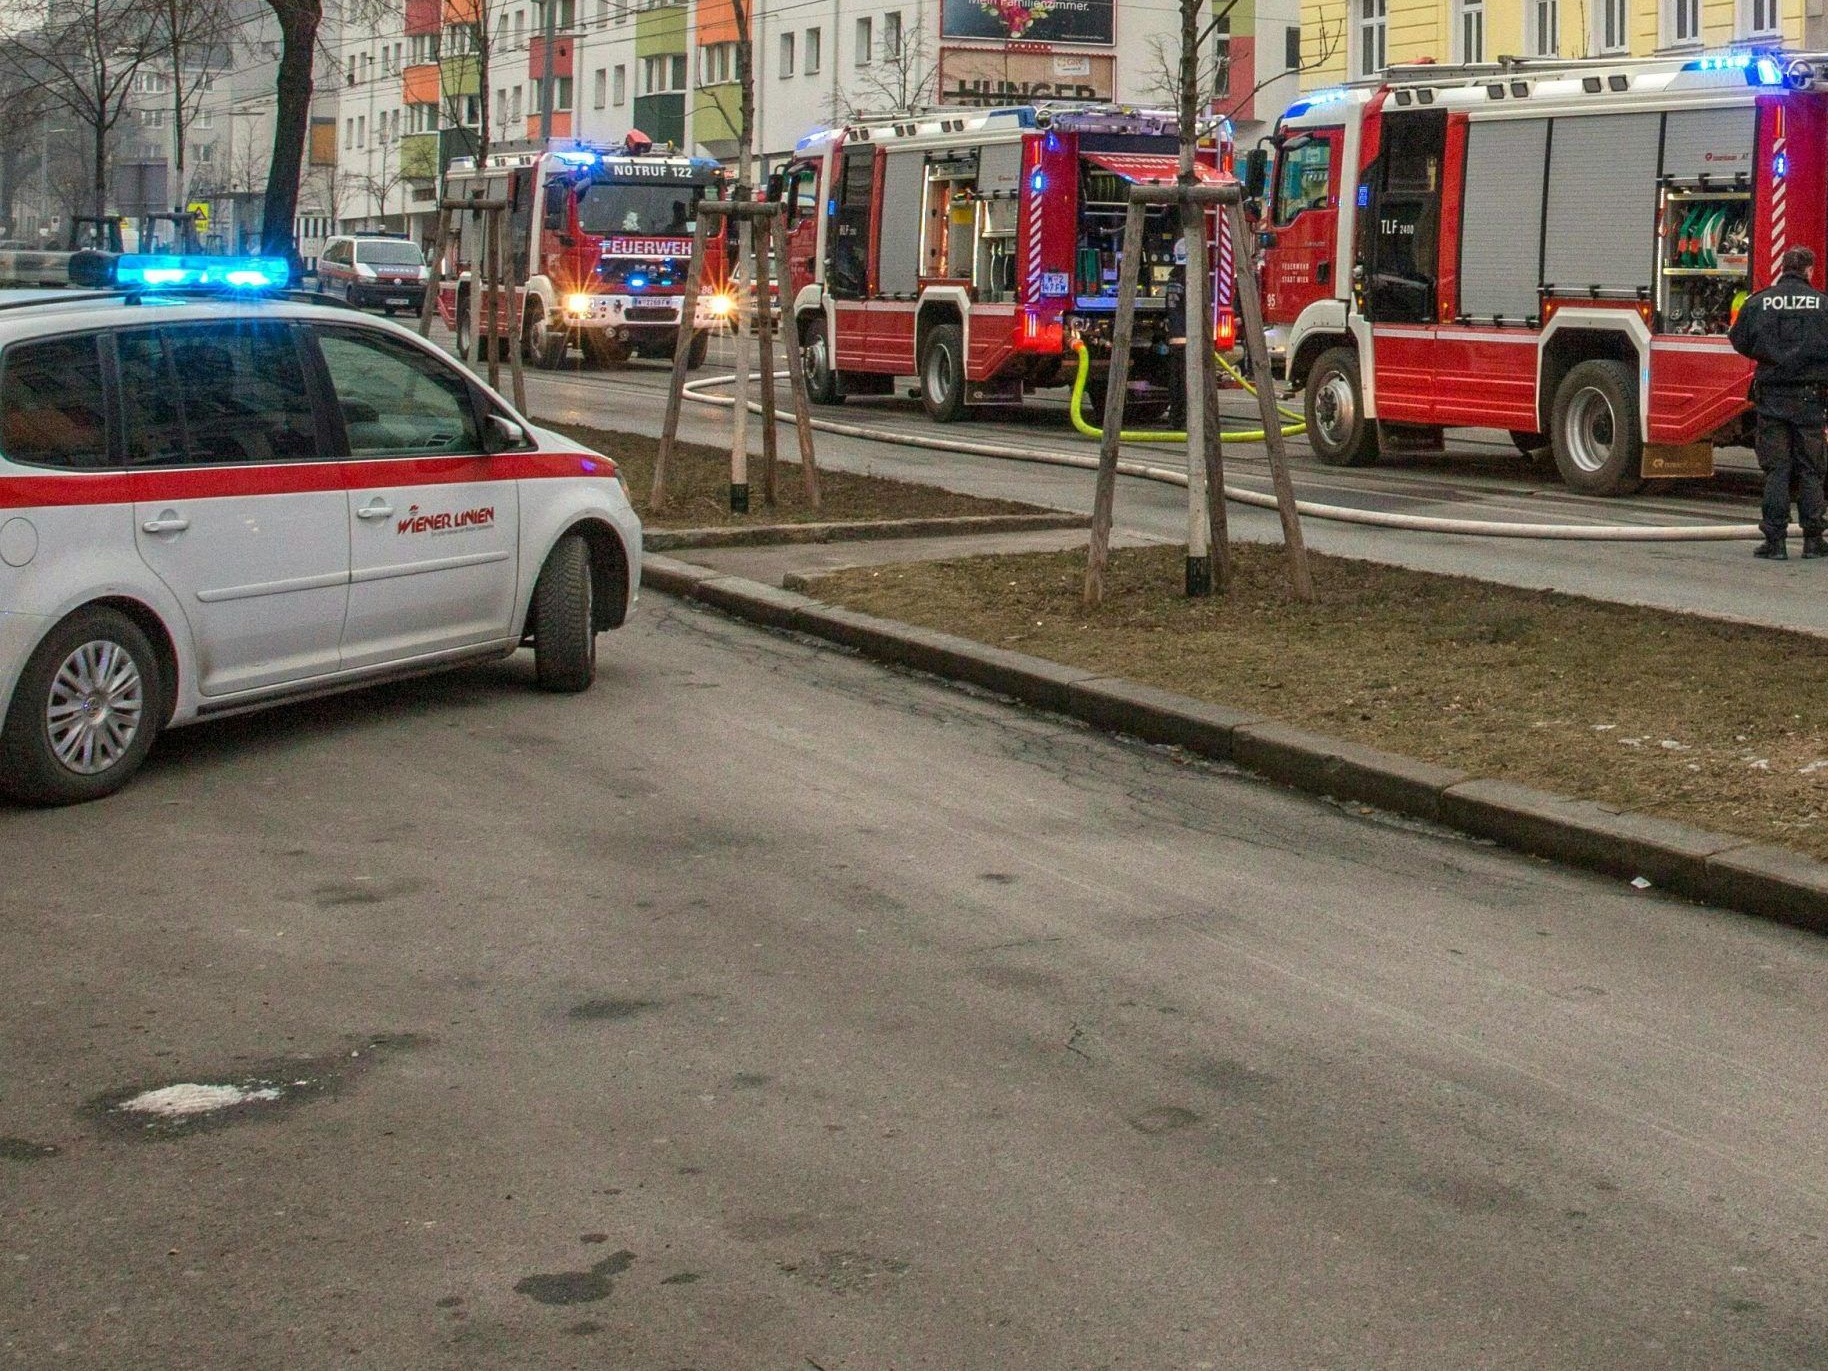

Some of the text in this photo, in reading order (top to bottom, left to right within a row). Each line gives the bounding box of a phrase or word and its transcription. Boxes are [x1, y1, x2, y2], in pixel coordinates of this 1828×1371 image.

[958, 79, 1097, 107] HUNGER
[614, 165, 693, 178] NOTRUF 122
[1381, 219, 1398, 235] TLF
[600, 241, 692, 255] FEUERWEH
[1266, 293, 1276, 307] 95
[1762, 295, 1821, 311] POLIZEI
[397, 513, 452, 535] WIENER
[454, 506, 495, 528] LINIEN
